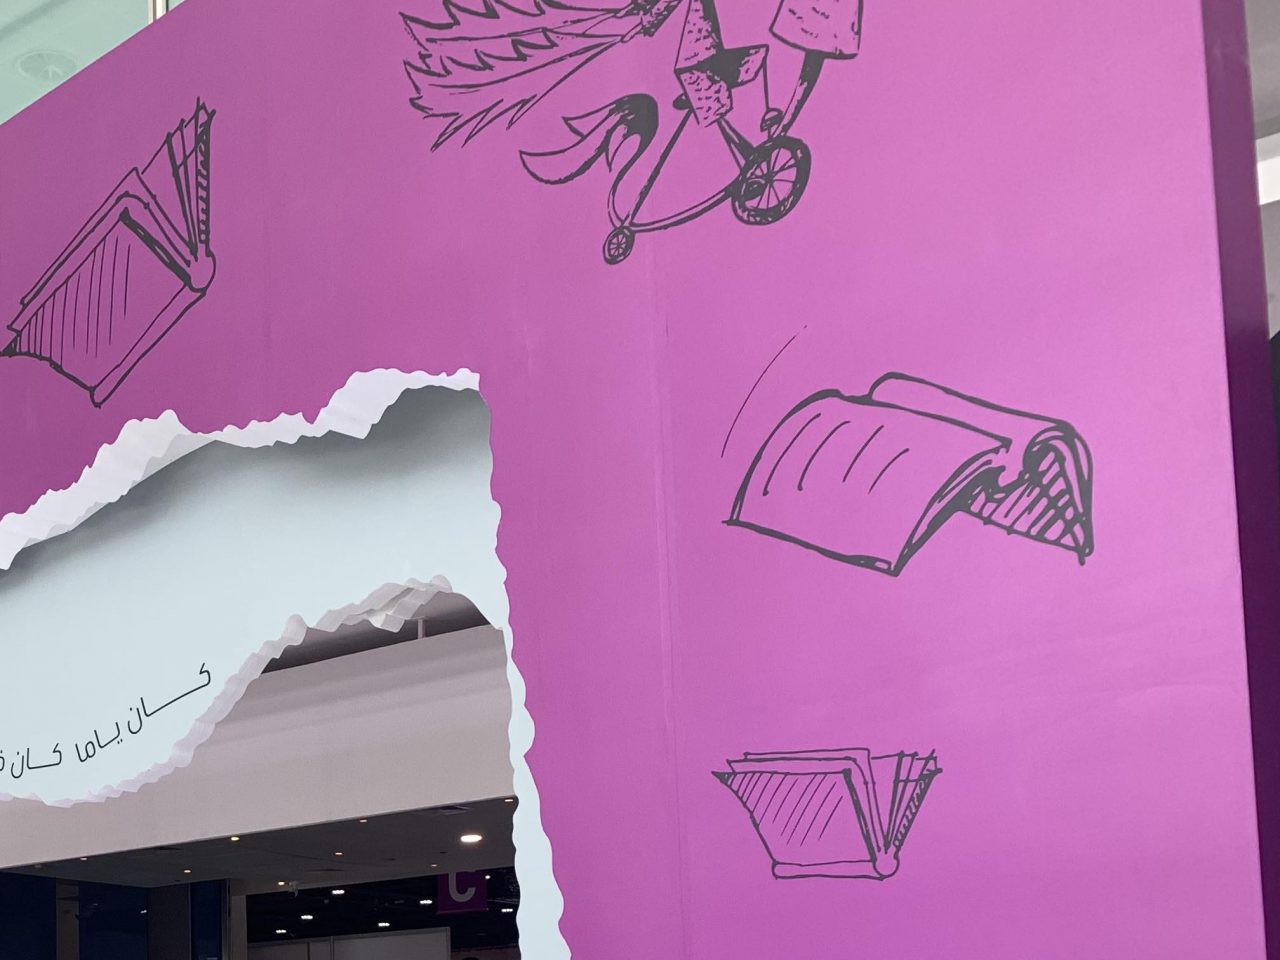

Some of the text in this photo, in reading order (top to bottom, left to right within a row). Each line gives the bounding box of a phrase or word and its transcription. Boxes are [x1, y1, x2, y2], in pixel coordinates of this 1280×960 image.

[127, 662, 211, 734] كان
[10, 743, 62, 779] كان
[75, 722, 123, 763] ياما
